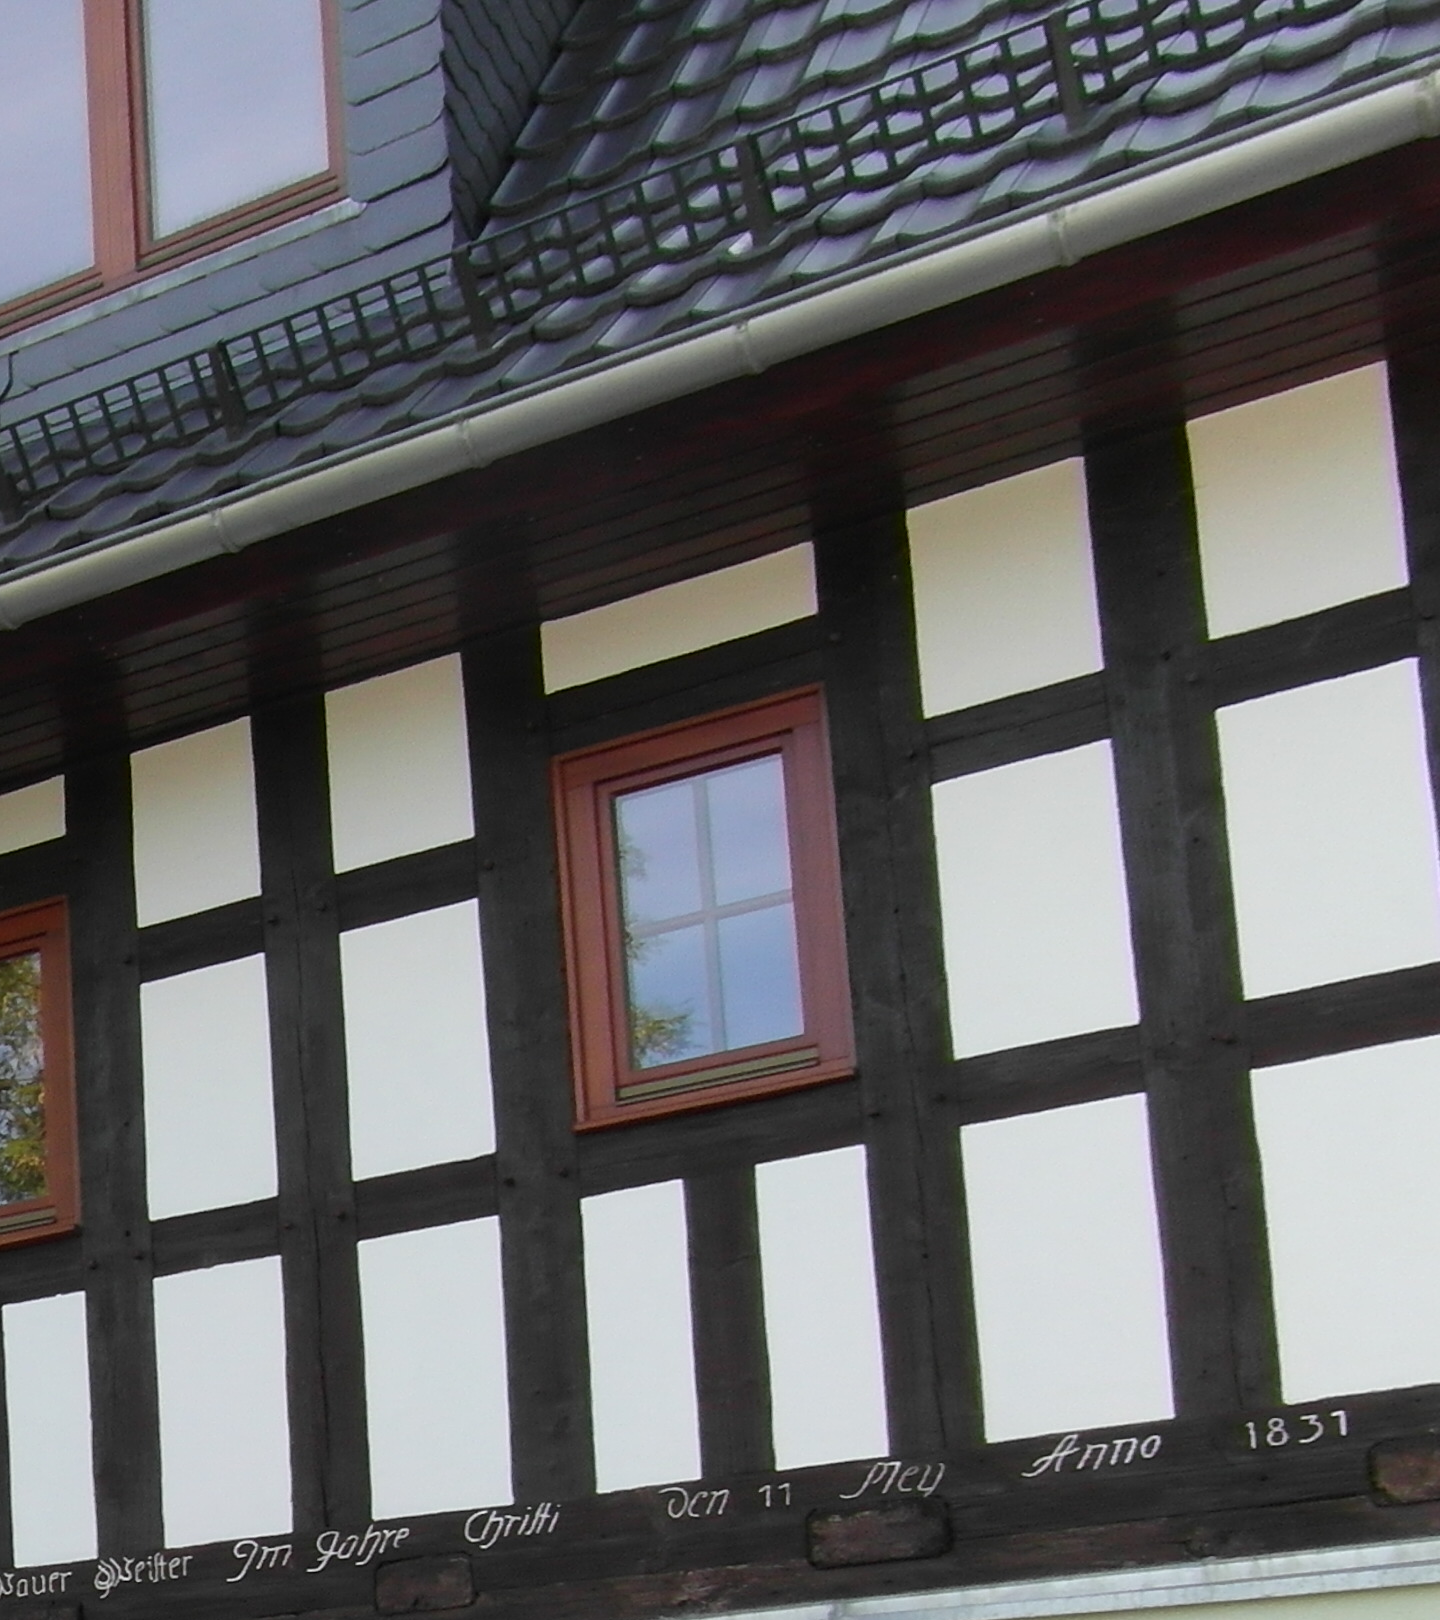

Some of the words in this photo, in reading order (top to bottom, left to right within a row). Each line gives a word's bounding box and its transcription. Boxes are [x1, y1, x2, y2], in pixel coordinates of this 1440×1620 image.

[93, 1552, 193, 1599] Meister
[307, 1522, 411, 1573] Jahre
[463, 1502, 562, 1550] Christi
[758, 1483, 793, 1508] 11
[840, 1460, 947, 1499] Mey
[1020, 1432, 1162, 1477] Anno
[1244, 1408, 1351, 1450] 1831
